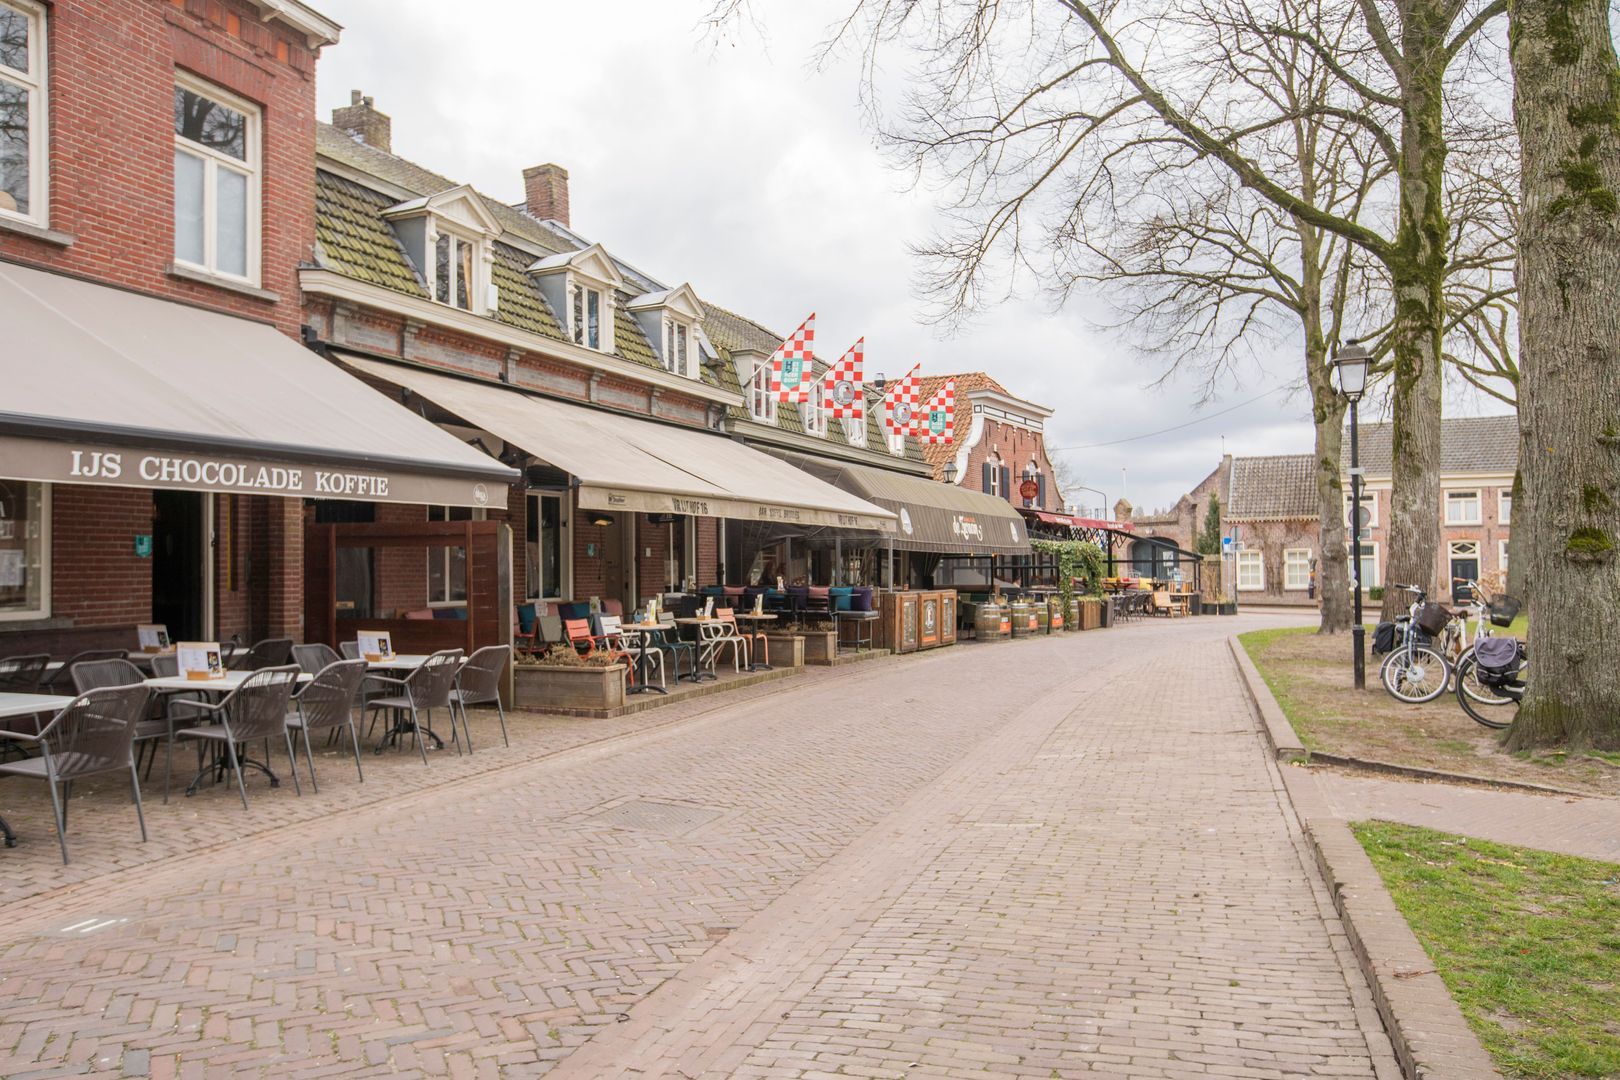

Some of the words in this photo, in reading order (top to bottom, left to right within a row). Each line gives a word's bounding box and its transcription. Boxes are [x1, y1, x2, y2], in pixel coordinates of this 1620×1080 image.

[70, 451, 121, 478] IJS
[139, 456, 302, 490] CHOCOLADE
[315, 471, 388, 496] KOFFIE
